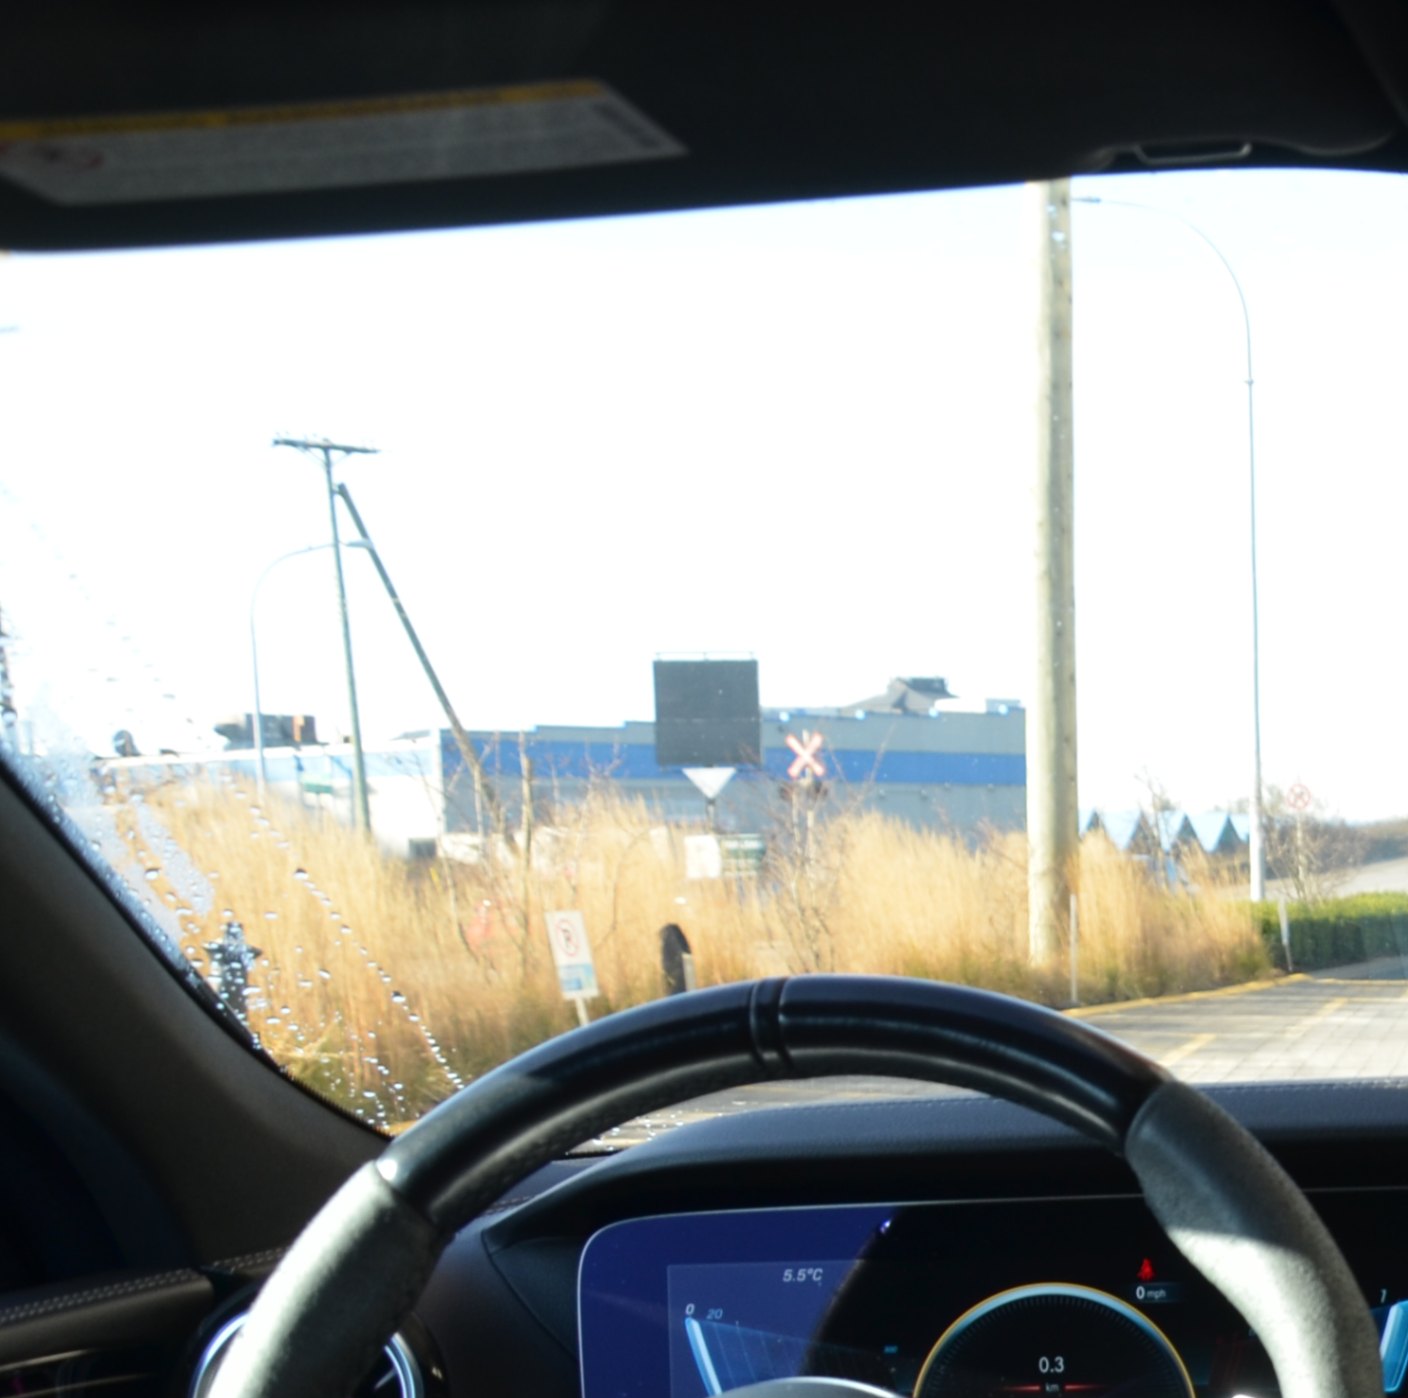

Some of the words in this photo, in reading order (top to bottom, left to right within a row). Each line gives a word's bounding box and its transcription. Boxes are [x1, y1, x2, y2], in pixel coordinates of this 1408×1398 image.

[1136, 1286, 1145, 1300] 0
[1147, 1288, 1166, 1299] mph
[685, 1303, 695, 1316] 0
[706, 1308, 723, 1320] 20
[1038, 1356, 1065, 1373] 0.3
[1045, 1381, 1060, 1392] km
